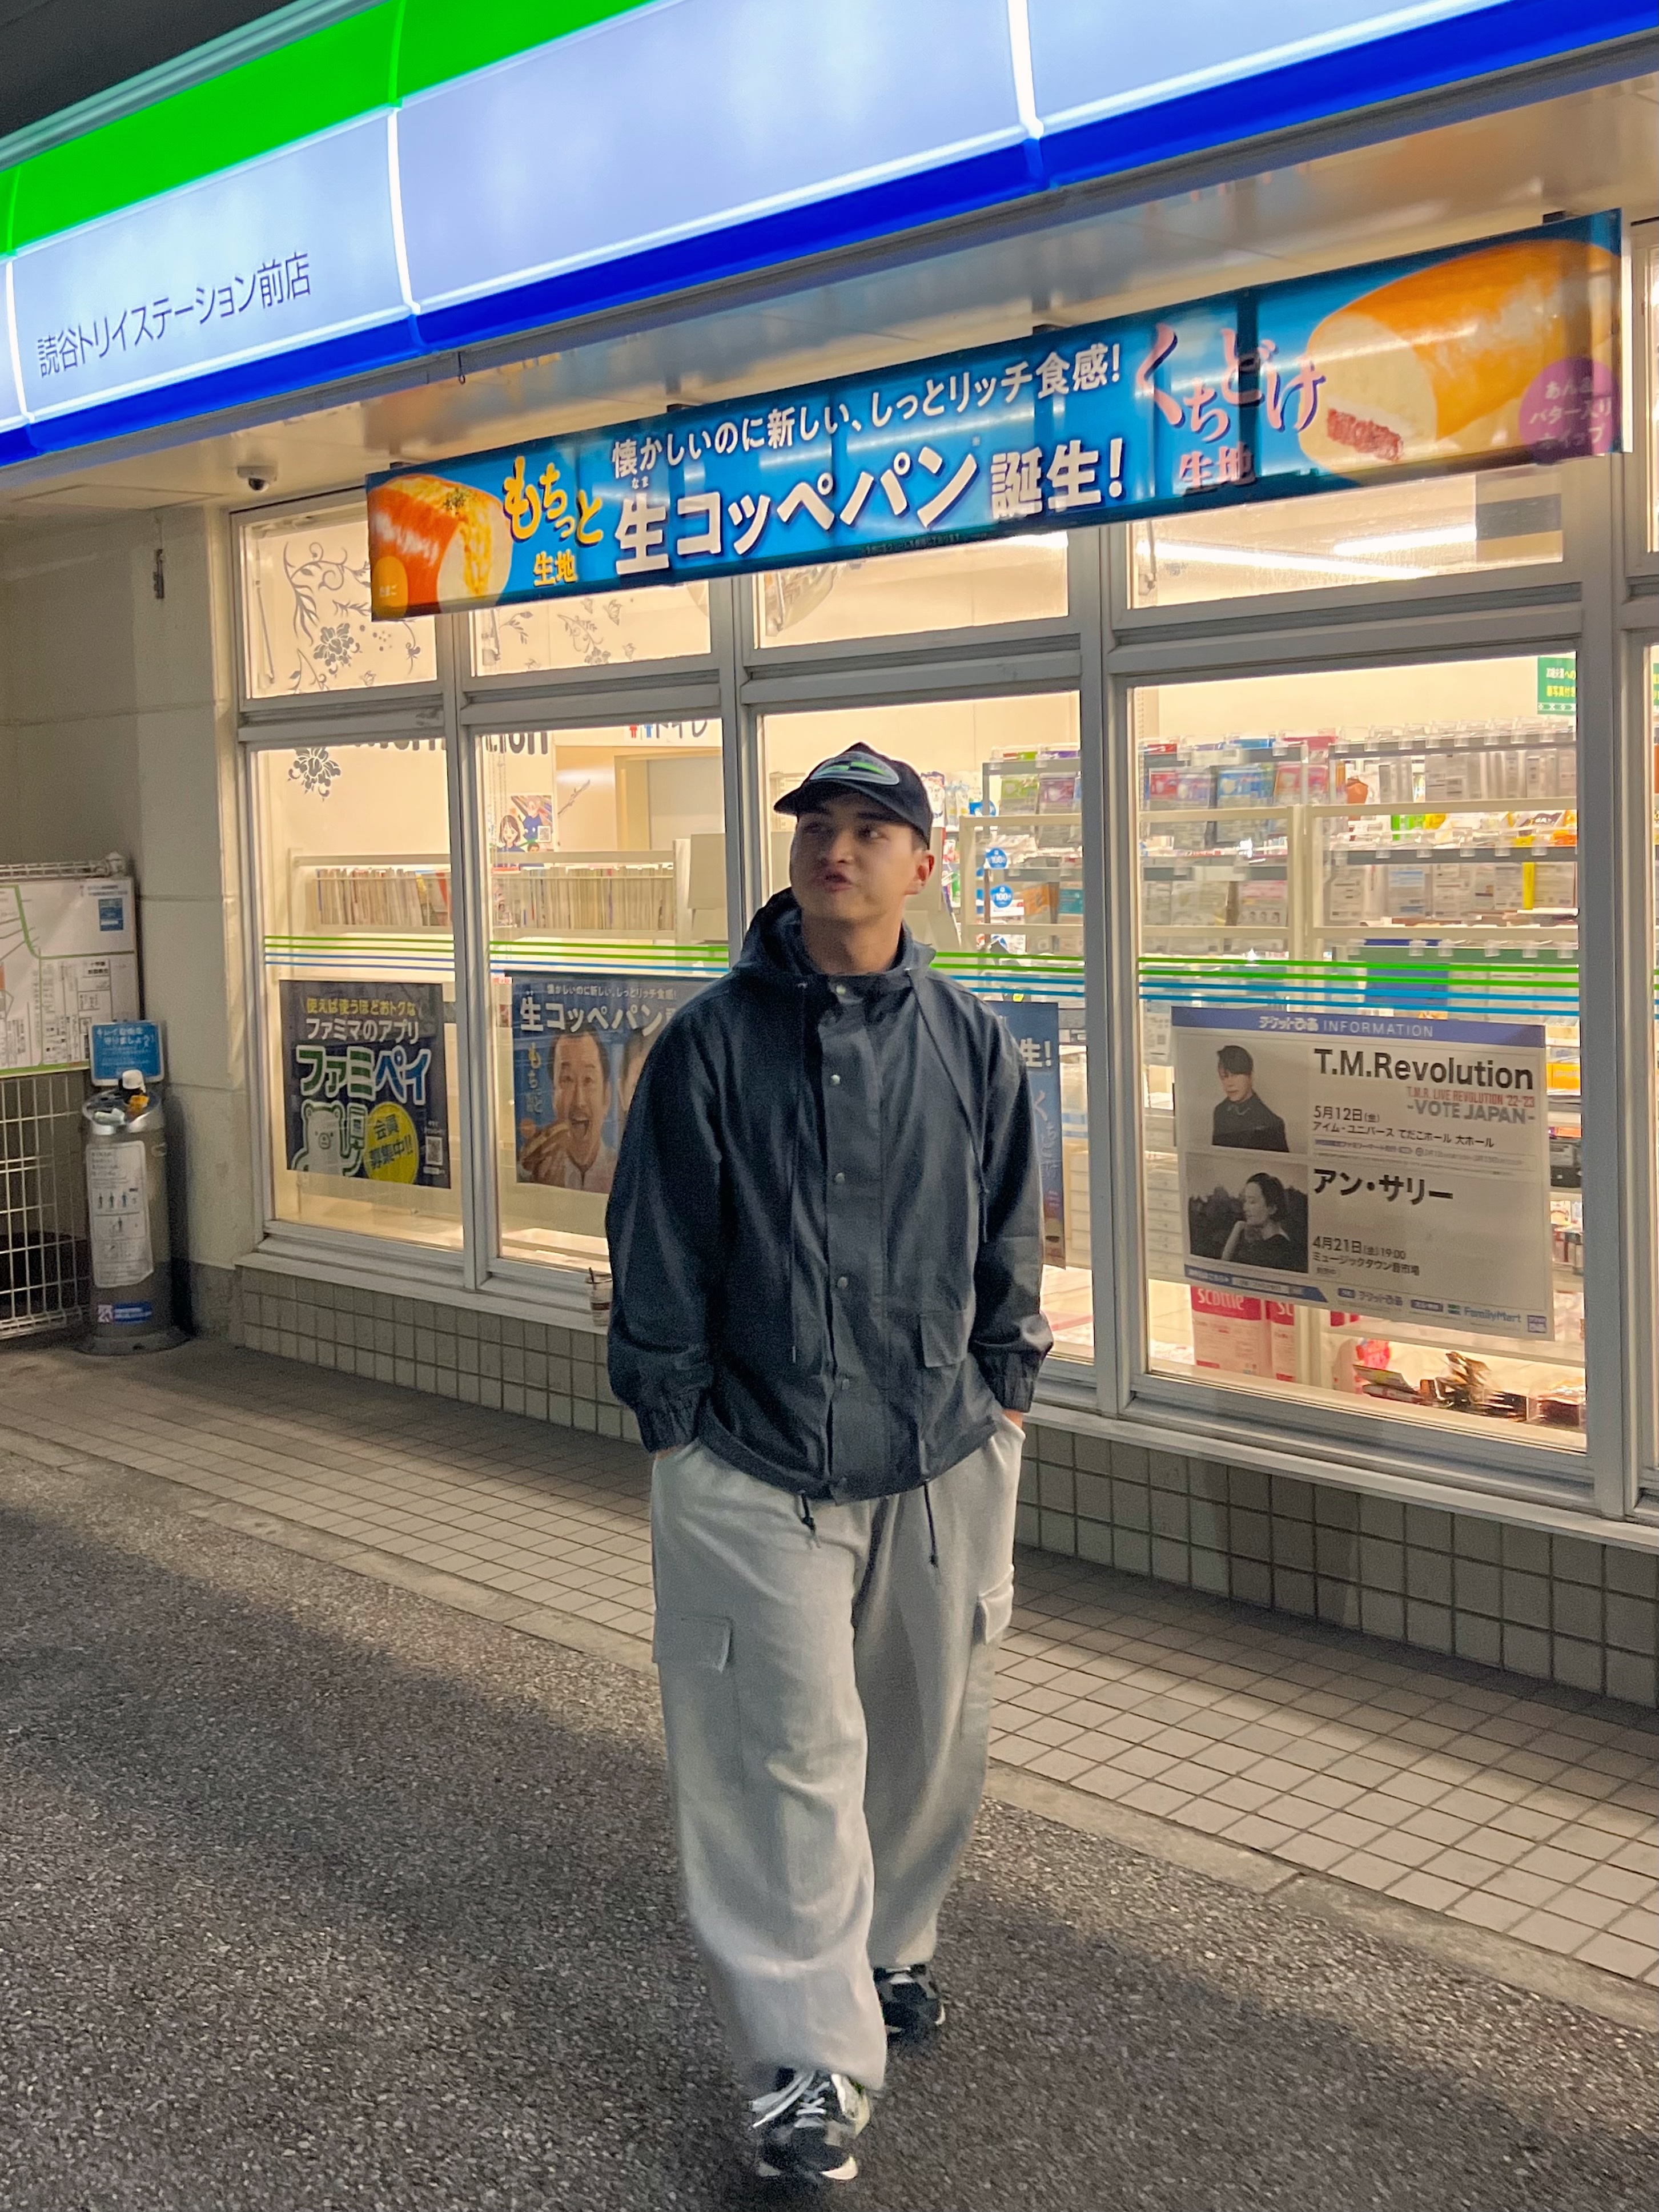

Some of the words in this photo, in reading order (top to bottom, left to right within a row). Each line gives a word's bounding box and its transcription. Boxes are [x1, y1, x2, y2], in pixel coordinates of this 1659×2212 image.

[37, 251, 312, 379] 読谷トリイステーション前店
[1134, 322, 1326, 443] くちどけ
[1179, 442, 1254, 489] 生地
[503, 456, 604, 545] もちっと
[533, 548, 578, 588] 生地
[306, 997, 416, 1016] 使えば使うほどおトクな
[520, 996, 676, 1037] 生コッペパン
[306, 1017, 419, 1045] ファミマのアプリ
[1323, 1019, 1434, 1037] INFORMATION
[296, 1044, 431, 1106] ファミペイ
[1313, 1048, 1534, 1090] T.M.Revolution
[1313, 1105, 1380, 1123] 5月12日(金)
[1434, 1088, 1451, 1101] LIVE
[1453, 1090, 1503, 1105] REVOLUTION
[373, 1113, 399, 1140] 会員
[1399, 1128, 1452, 1144] てだこホール
[1456, 1134, 1495, 1148] 大ホール
[1313, 1168, 1453, 1205] アン・サリー
